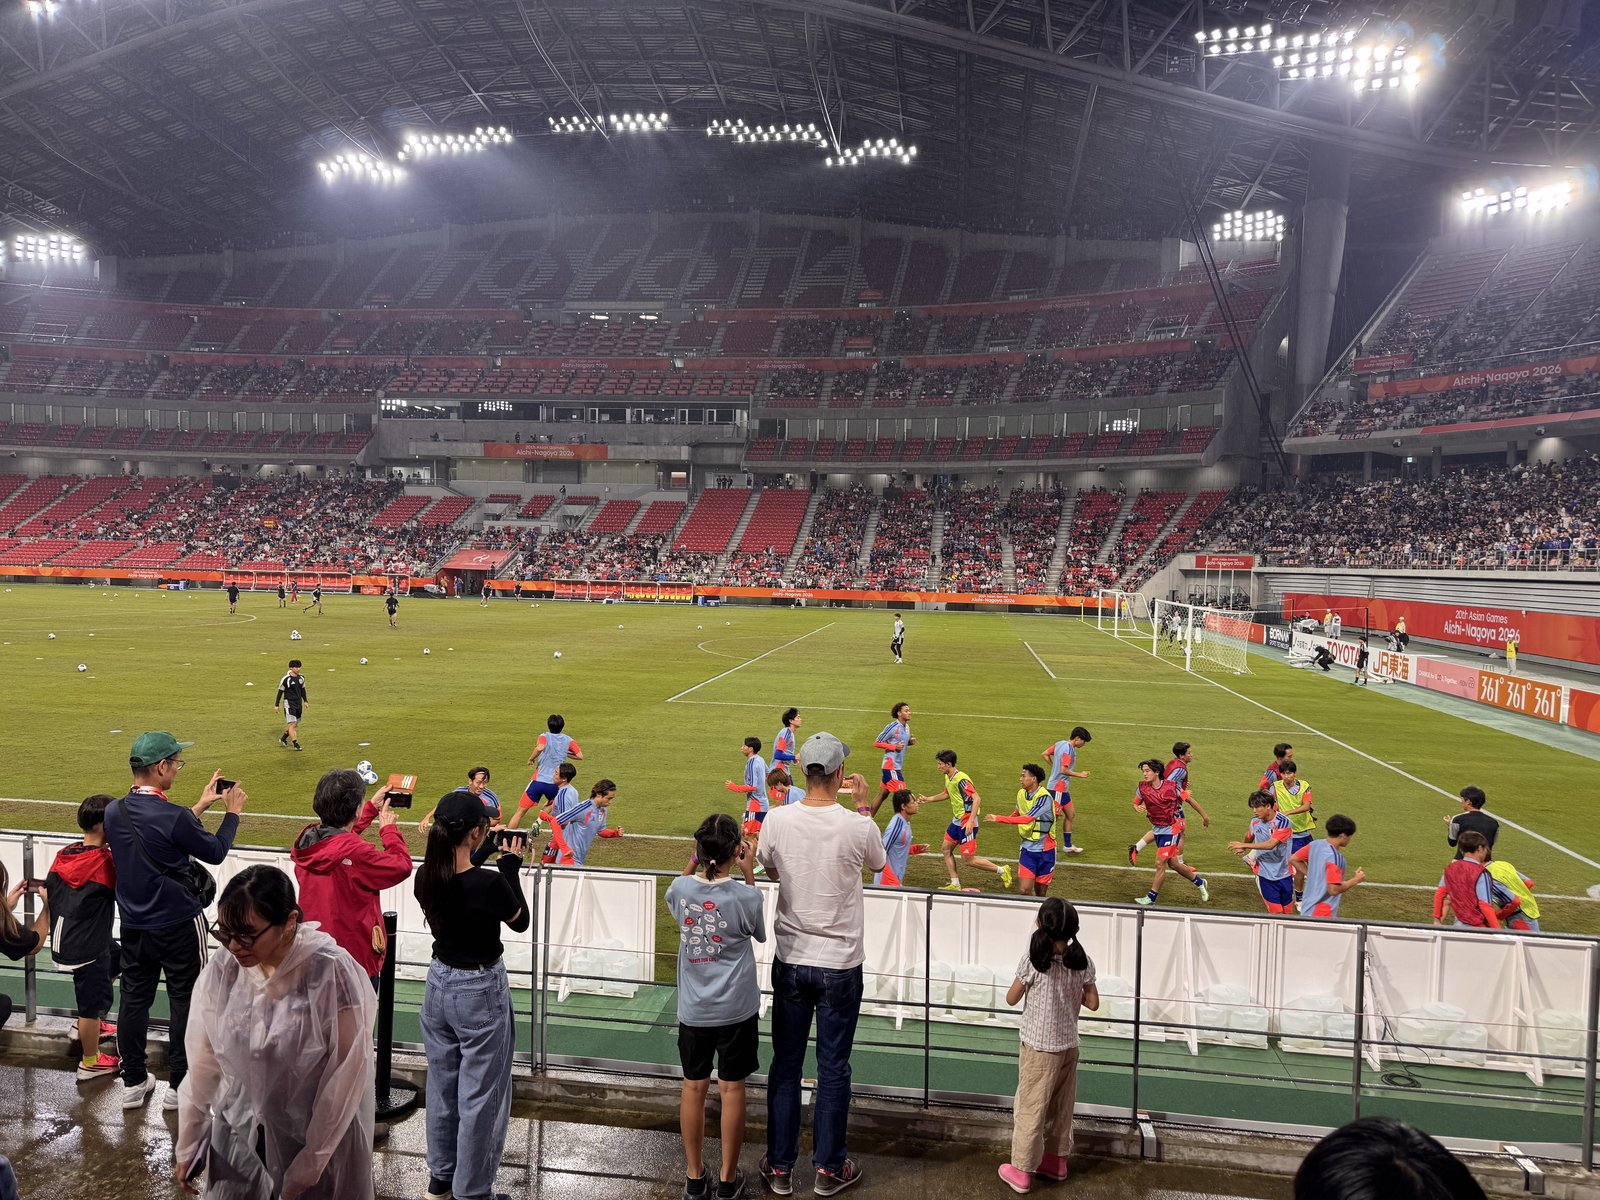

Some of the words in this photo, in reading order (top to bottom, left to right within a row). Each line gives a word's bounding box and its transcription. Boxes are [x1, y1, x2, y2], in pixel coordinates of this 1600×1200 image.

[413, 247, 869, 299] TOYOTA
[1453, 369, 1530, 387] Aichi-Nagoya
[1532, 364, 1562, 377] 2026
[516, 448, 558, 458] Aichi-Nagoya
[1455, 609, 1468, 620] 20th
[1468, 611, 1485, 622] Asian
[1485, 612, 1508, 624] Games
[1443, 620, 1497, 643] Aichi-Nagoya
[1326, 640, 1361, 666] TOYOTA
[1372, 650, 1410, 680] JR東海
[1480, 675, 1504, 703] 361°
[1506, 681, 1531, 711] 361°
[1533, 687, 1561, 718] 361°
